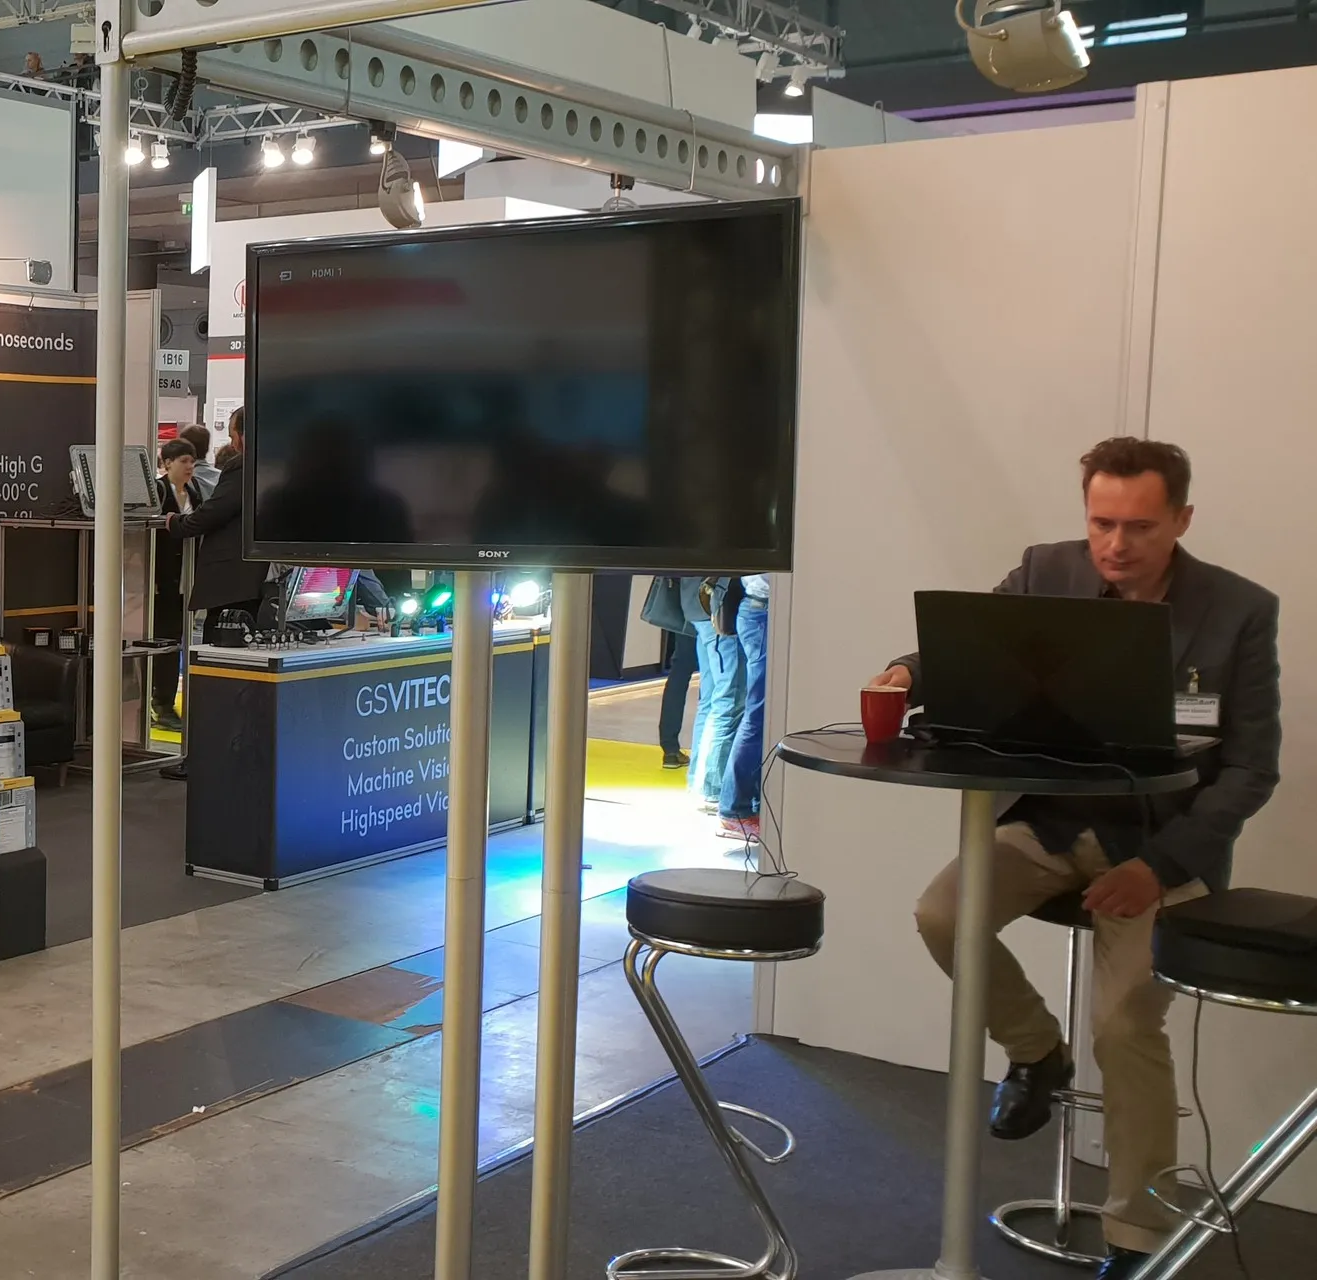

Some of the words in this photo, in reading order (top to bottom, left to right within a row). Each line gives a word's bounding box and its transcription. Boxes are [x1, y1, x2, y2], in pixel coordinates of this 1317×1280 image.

[311, 269, 335, 278] HDMI
[230, 341, 241, 350] 3D
[162, 353, 183, 365] 1B16
[159, 379, 168, 388] ES
[170, 379, 181, 389] AG
[30, 455, 43, 473] G
[478, 550, 510, 558] SONY
[343, 734, 400, 761] Custom
[347, 767, 414, 797] Machine
[418, 756, 451, 782] Visi
[341, 794, 422, 837] Highspeed
